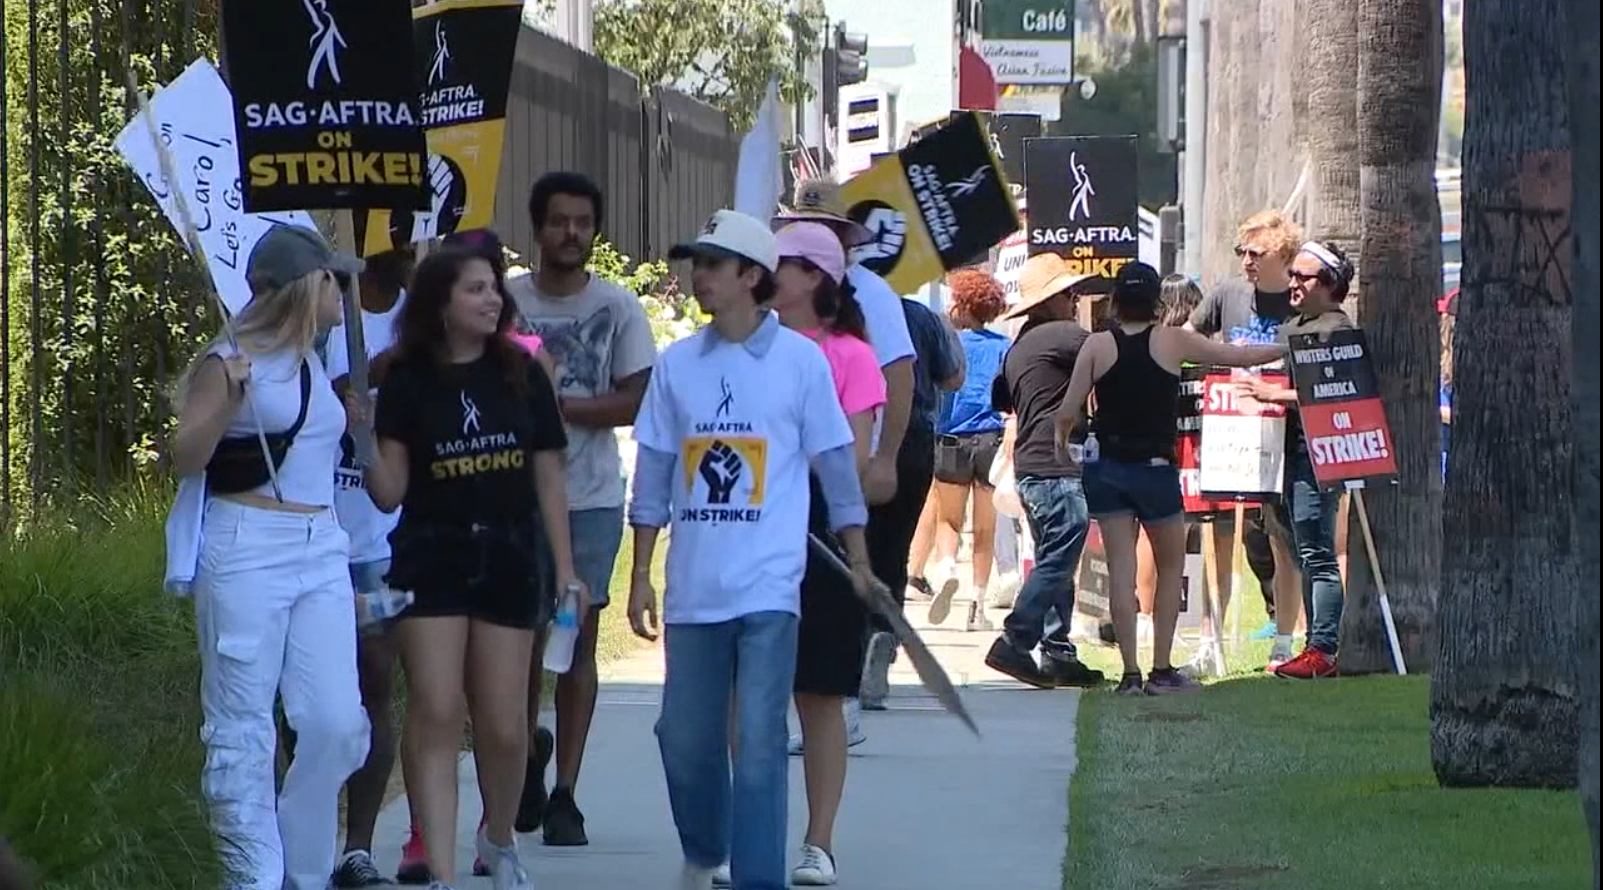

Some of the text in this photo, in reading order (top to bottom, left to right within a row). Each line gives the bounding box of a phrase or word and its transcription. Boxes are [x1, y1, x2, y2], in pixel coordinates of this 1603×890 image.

[1023, 8, 1066, 32] Café
[317, 131, 352, 148] ON
[248, 152, 421, 186] STRIKE!
[908, 164, 926, 189] ON
[1072, 246, 1094, 258] ON
[1294, 344, 1363, 364] WRITERS GUILD
[1313, 380, 1357, 398] AMERICA
[1333, 412, 1352, 429] ON
[1311, 428, 1389, 465] STRIKE!
[431, 449, 524, 480] STRONG
[700, 508, 761, 522] STRIKE!
